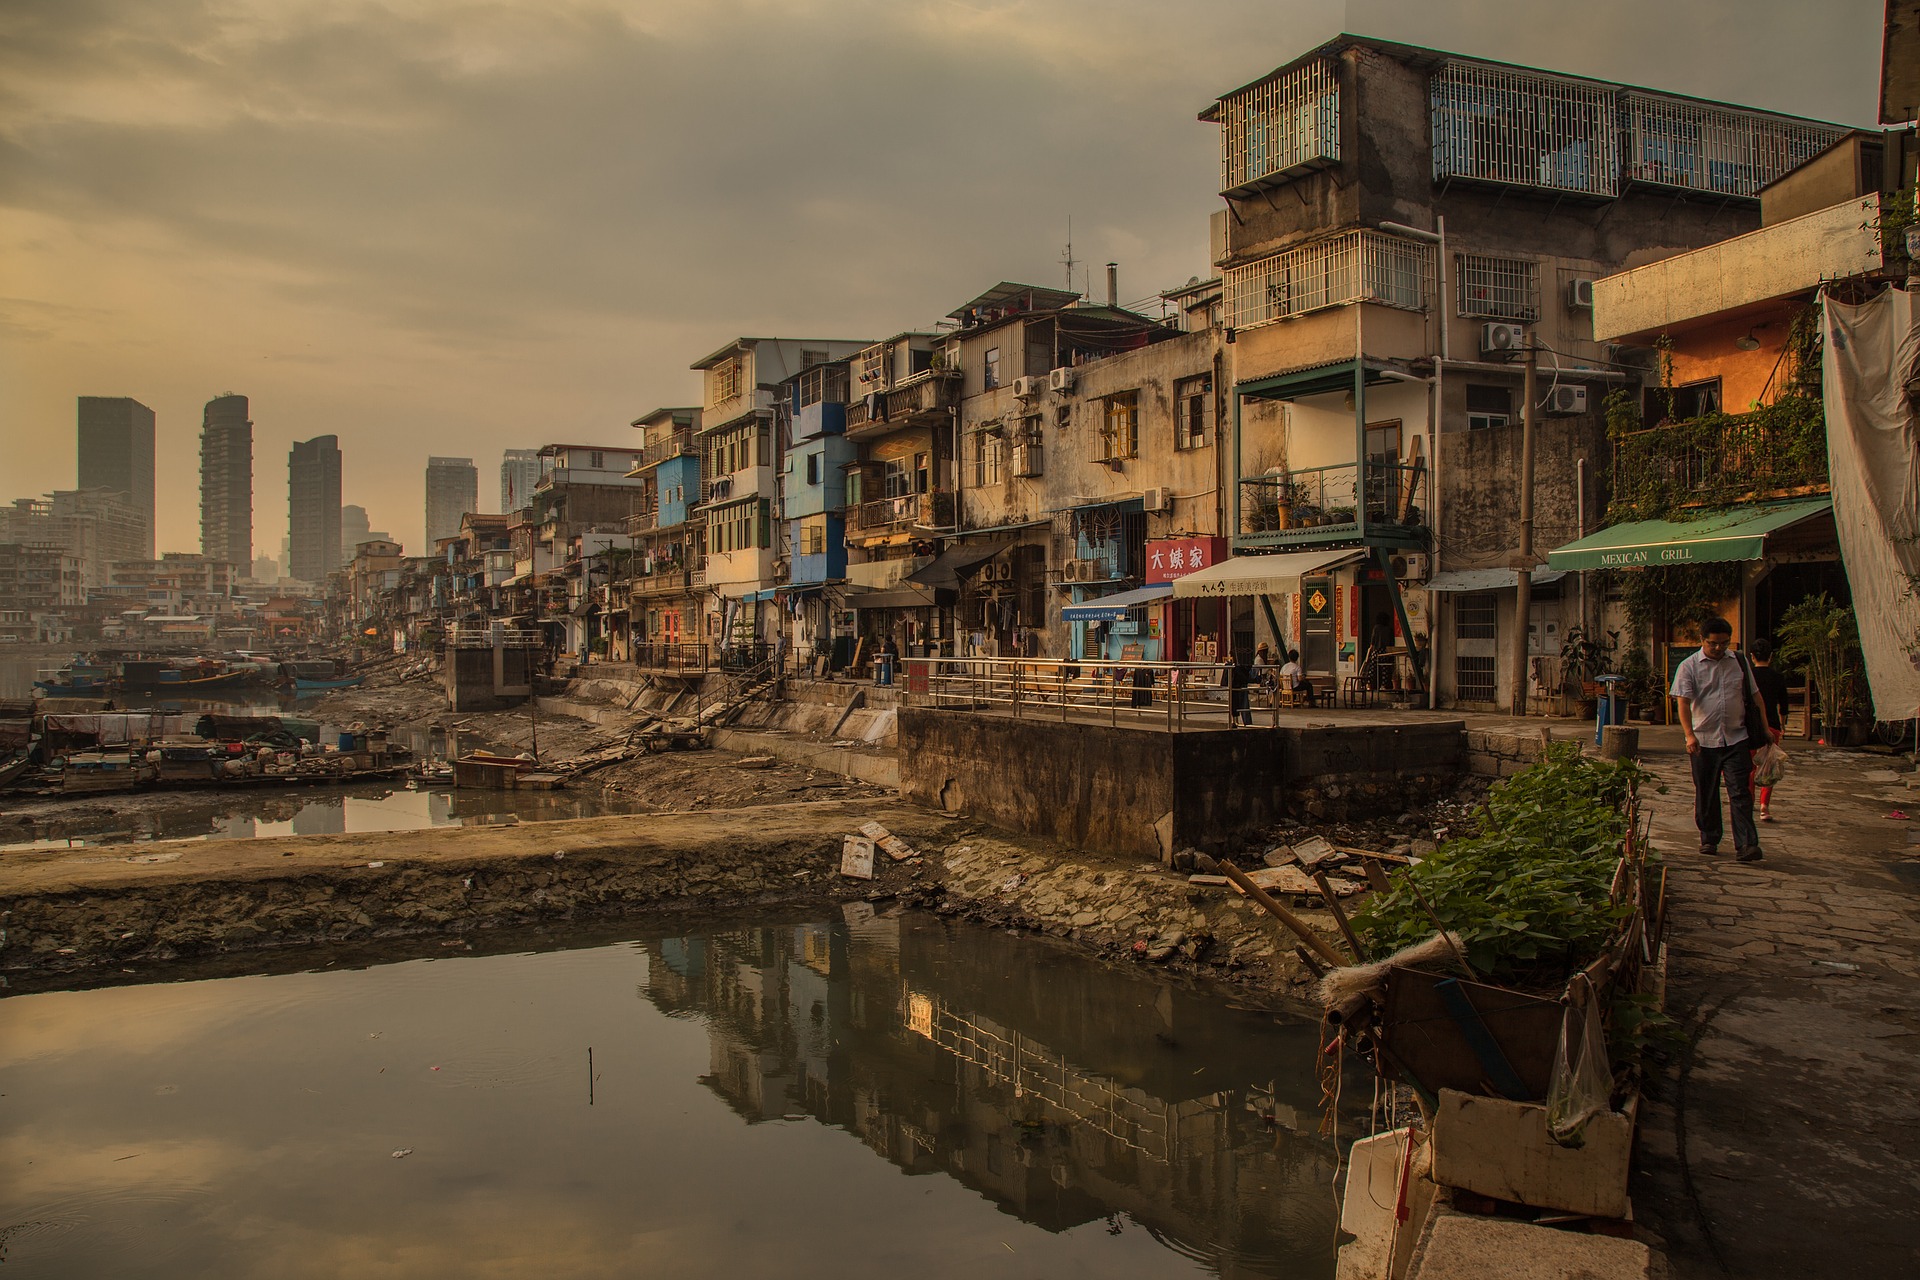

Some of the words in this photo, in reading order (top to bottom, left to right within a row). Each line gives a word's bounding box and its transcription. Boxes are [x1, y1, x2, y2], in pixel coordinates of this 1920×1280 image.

[1151, 546, 1203, 569] 大姨家
[1601, 551, 1647, 565] MEXICAN
[1661, 548, 1693, 560] GRILL
[1230, 581, 1268, 592] 生活美学馆
